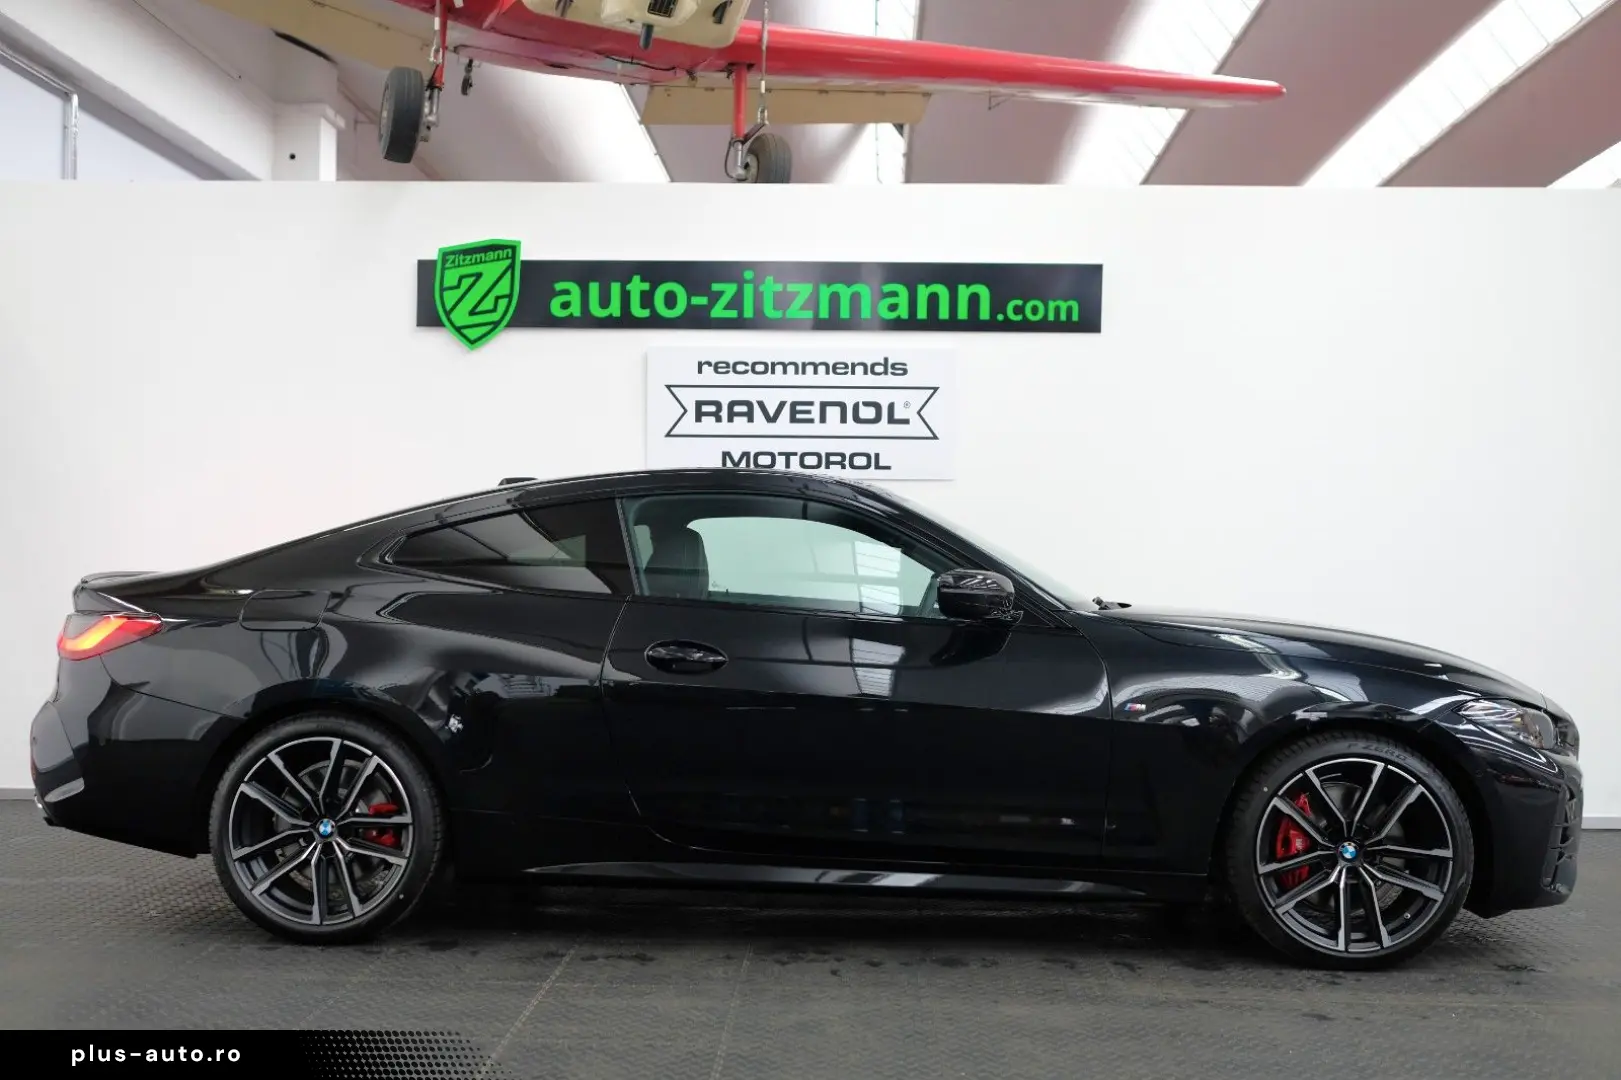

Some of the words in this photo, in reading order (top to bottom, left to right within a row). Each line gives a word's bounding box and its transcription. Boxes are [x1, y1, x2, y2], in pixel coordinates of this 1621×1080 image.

[444, 248, 513, 268] Zitzmann
[549, 268, 1080, 322] auto-zitzmann.com
[697, 357, 909, 377] recommends
[721, 450, 892, 470] MOTOROL
